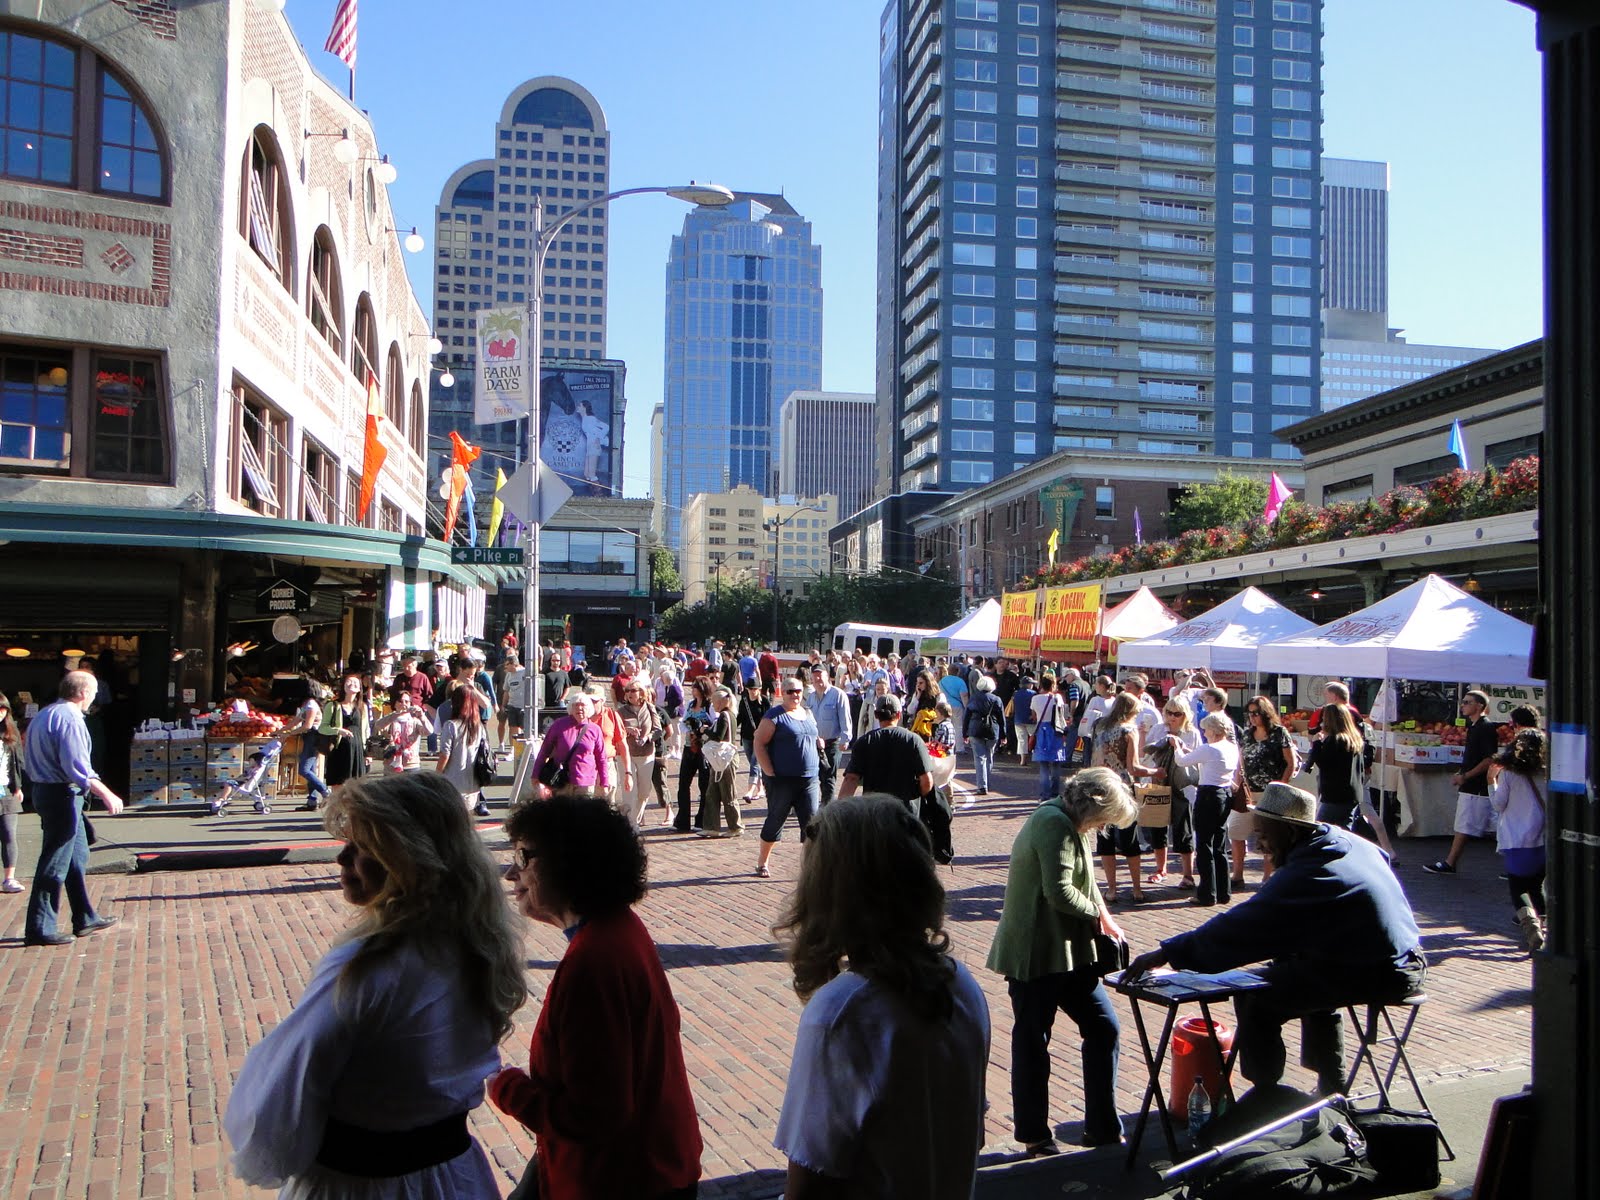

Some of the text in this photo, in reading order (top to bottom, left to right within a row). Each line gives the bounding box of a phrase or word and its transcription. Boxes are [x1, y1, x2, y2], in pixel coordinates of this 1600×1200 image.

[483, 366, 521, 379] FARM
[486, 378, 520, 391] DAYS
[473, 549, 519, 562] Pike Pl
[271, 587, 295, 598] CORNER
[269, 599, 296, 610] PRODUCE
[1060, 591, 1087, 611] ORGANIC
[1043, 611, 1097, 640] SMOOTHIES
[1480, 684, 1528, 699] Martin
